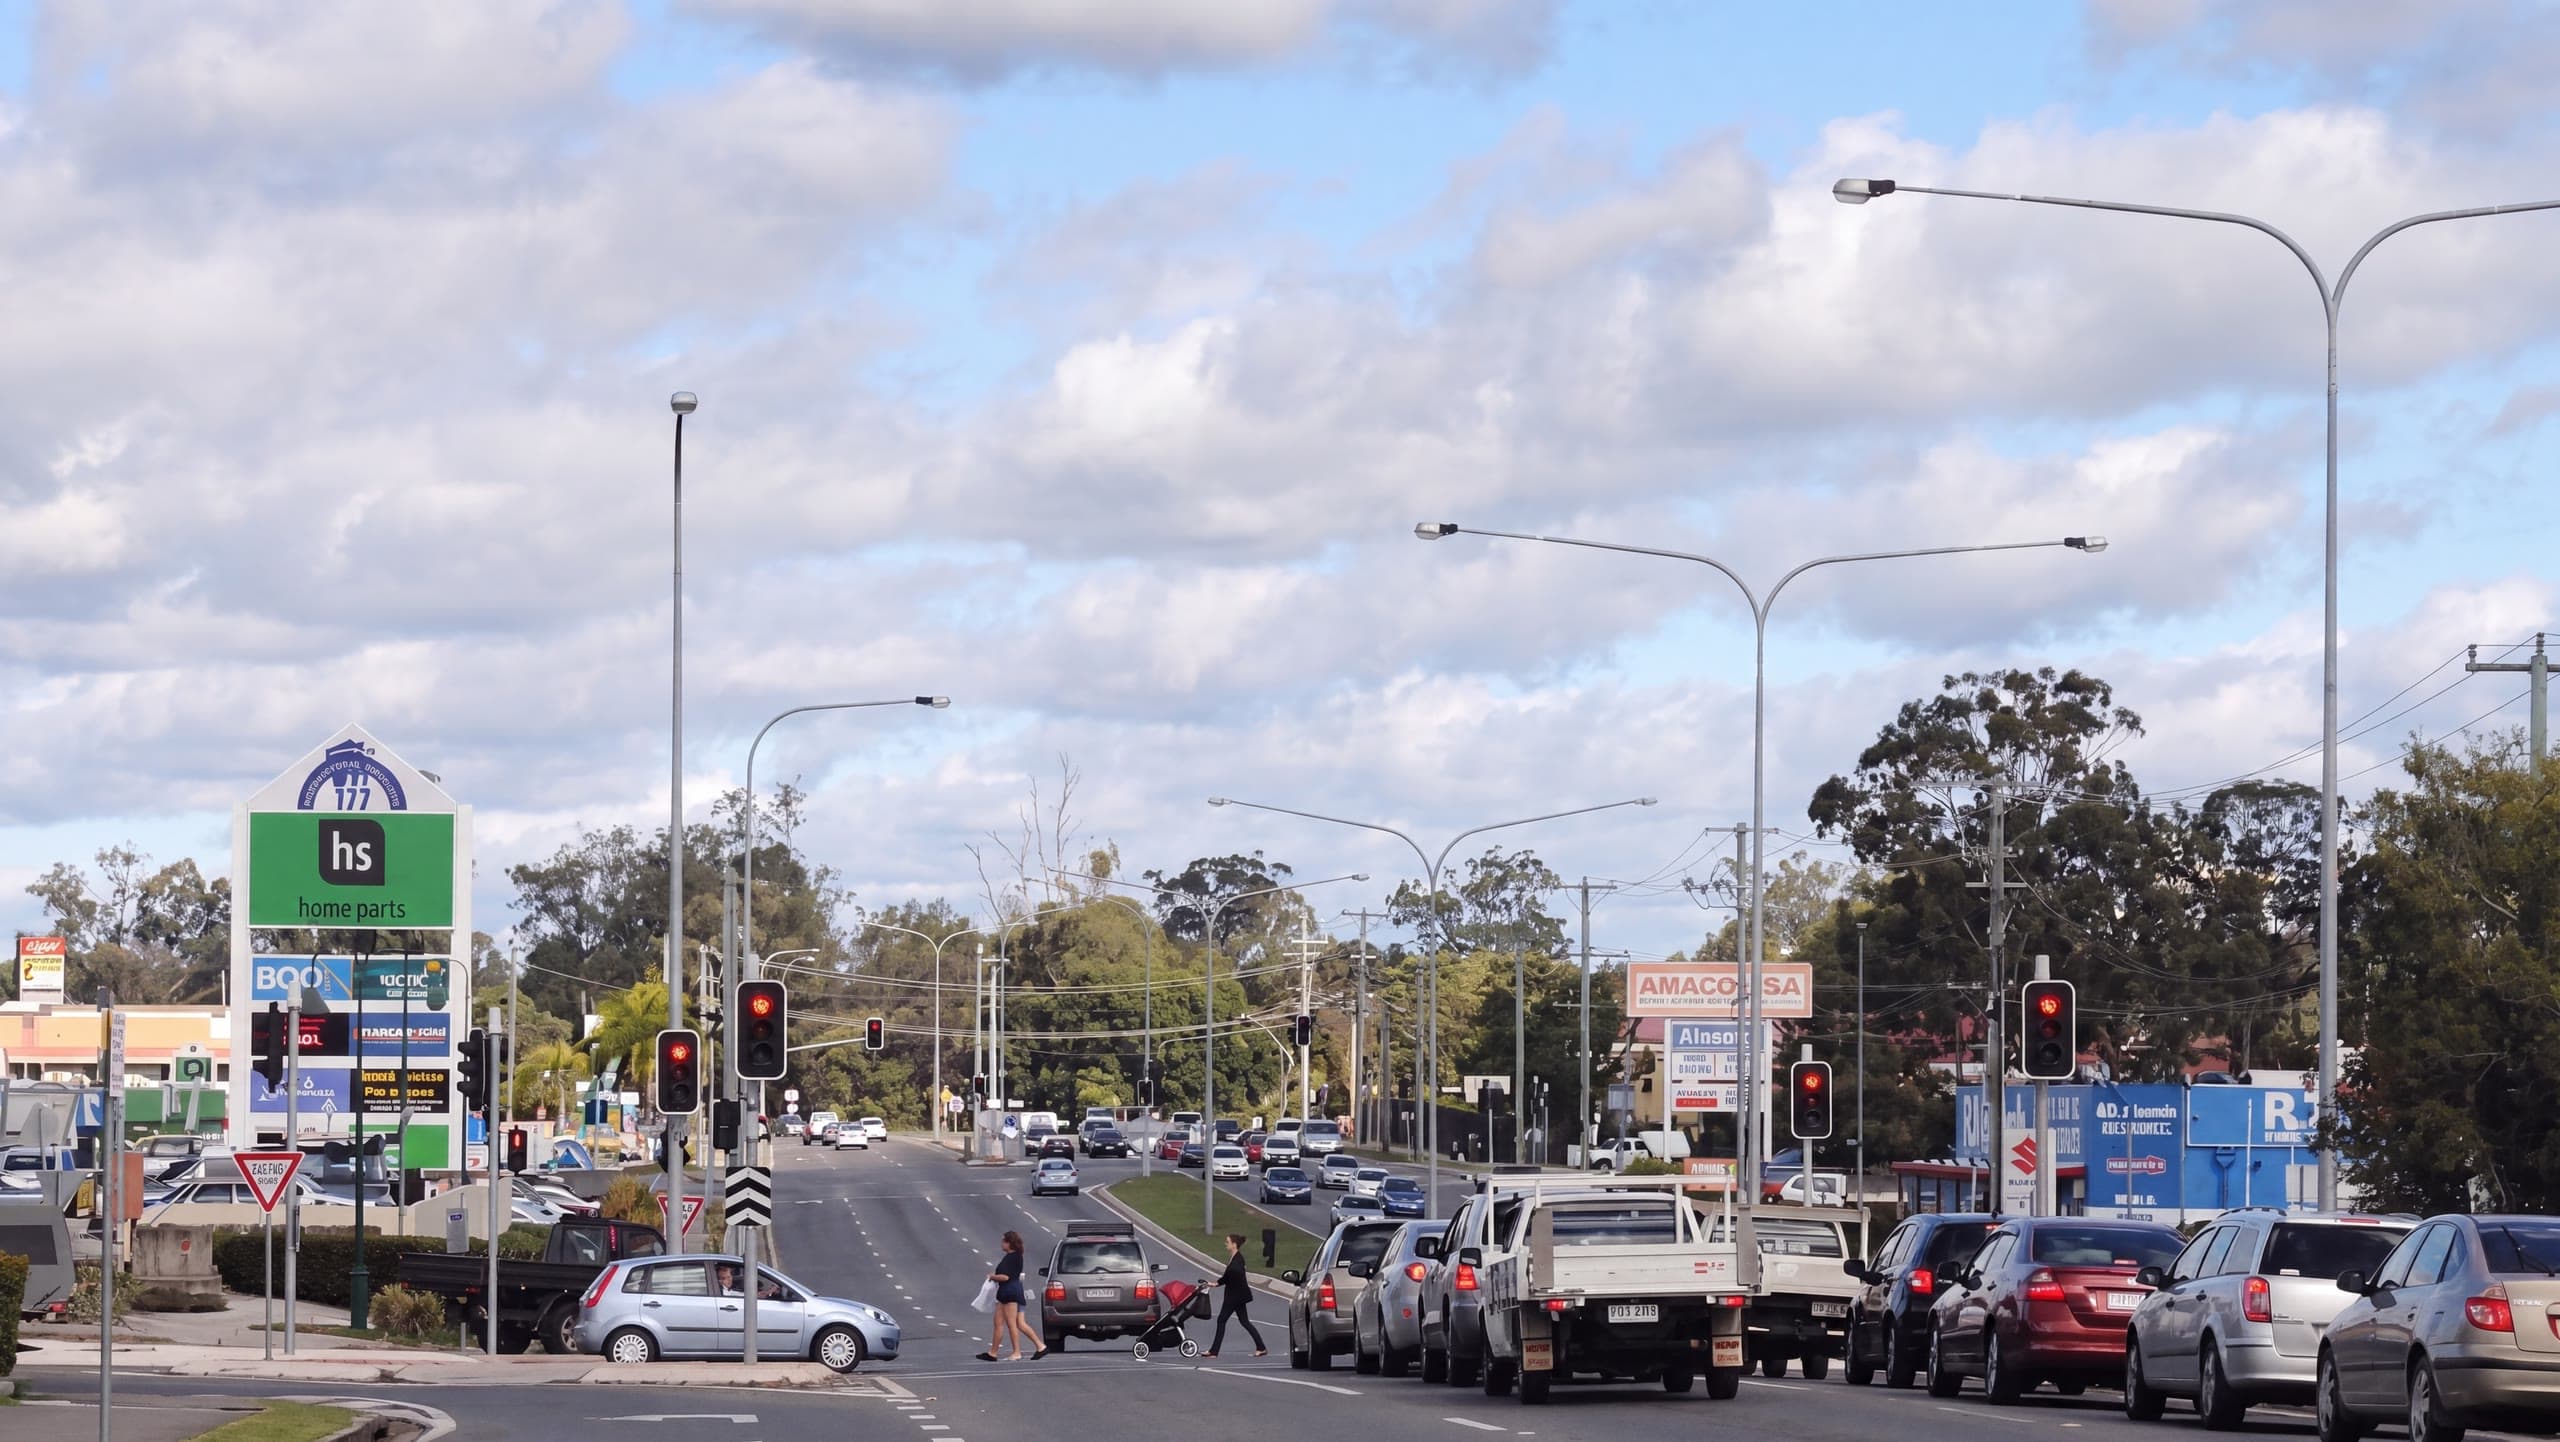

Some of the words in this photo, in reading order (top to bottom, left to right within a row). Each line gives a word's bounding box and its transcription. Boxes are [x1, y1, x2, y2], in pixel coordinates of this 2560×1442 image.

[332, 830, 372, 872] hs
[299, 896, 351, 919] home
[356, 899, 406, 922] parts
